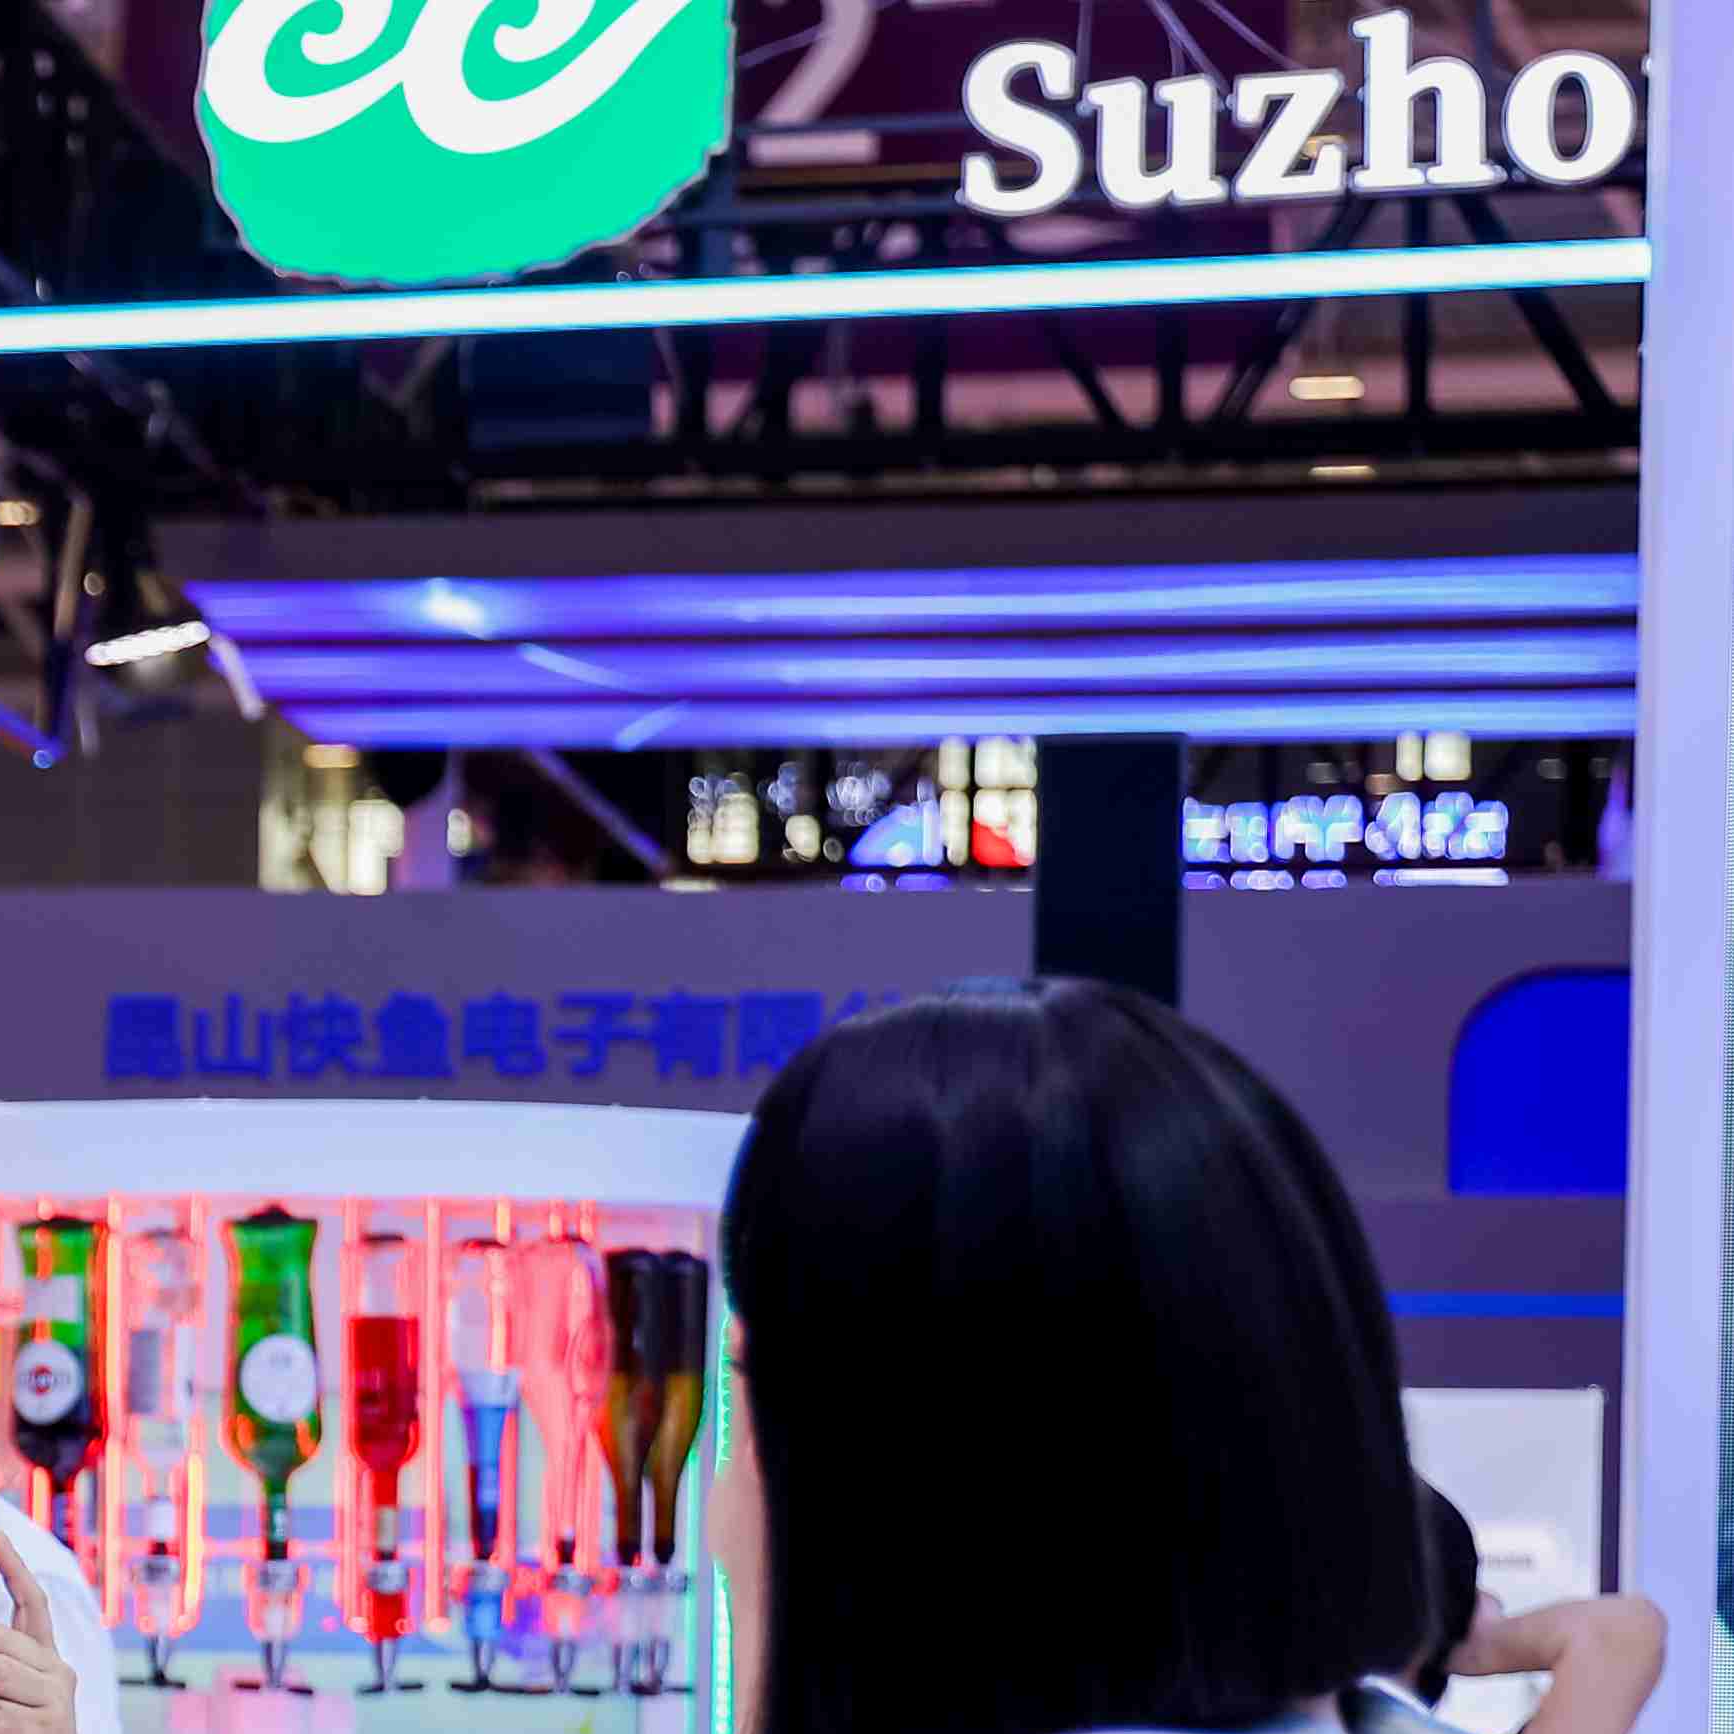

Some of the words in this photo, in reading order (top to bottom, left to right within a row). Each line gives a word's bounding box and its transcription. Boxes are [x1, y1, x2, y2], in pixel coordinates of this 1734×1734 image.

[959, 8, 1640, 216] Suzho
[104, 988, 901, 1082] 昆山快鱼电子有限
